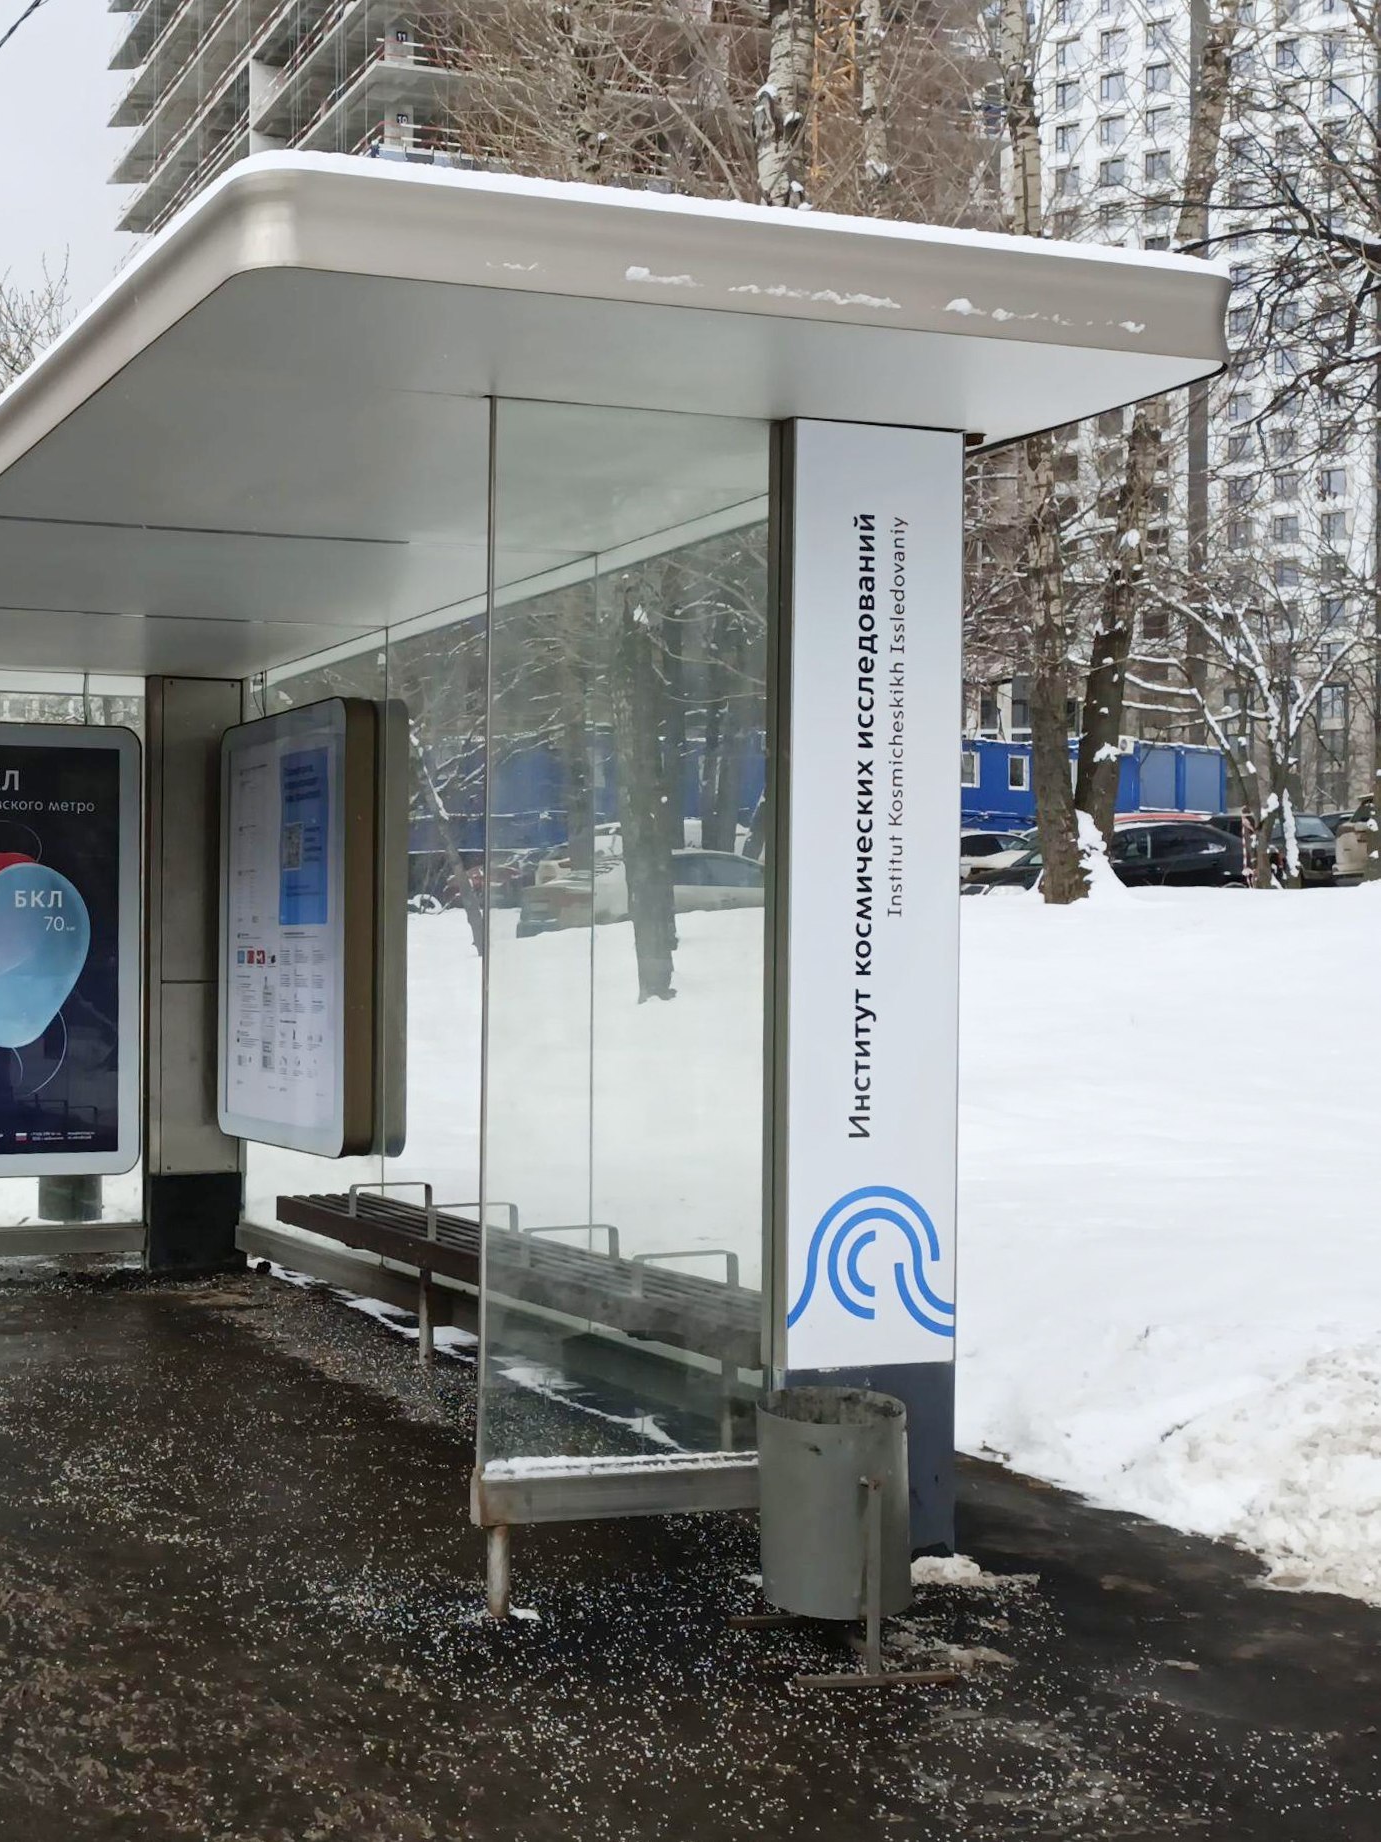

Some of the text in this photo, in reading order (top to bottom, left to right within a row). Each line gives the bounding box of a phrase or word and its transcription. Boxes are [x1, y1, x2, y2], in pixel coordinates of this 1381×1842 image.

[887, 516, 908, 918] Institut Kosmicheskikh Issledovaniy
[48, 800, 96, 814] метро
[848, 513, 878, 1139] Институт космических исследований
[14, 890, 63, 908] БКЛ
[43, 915, 65, 932] 70
